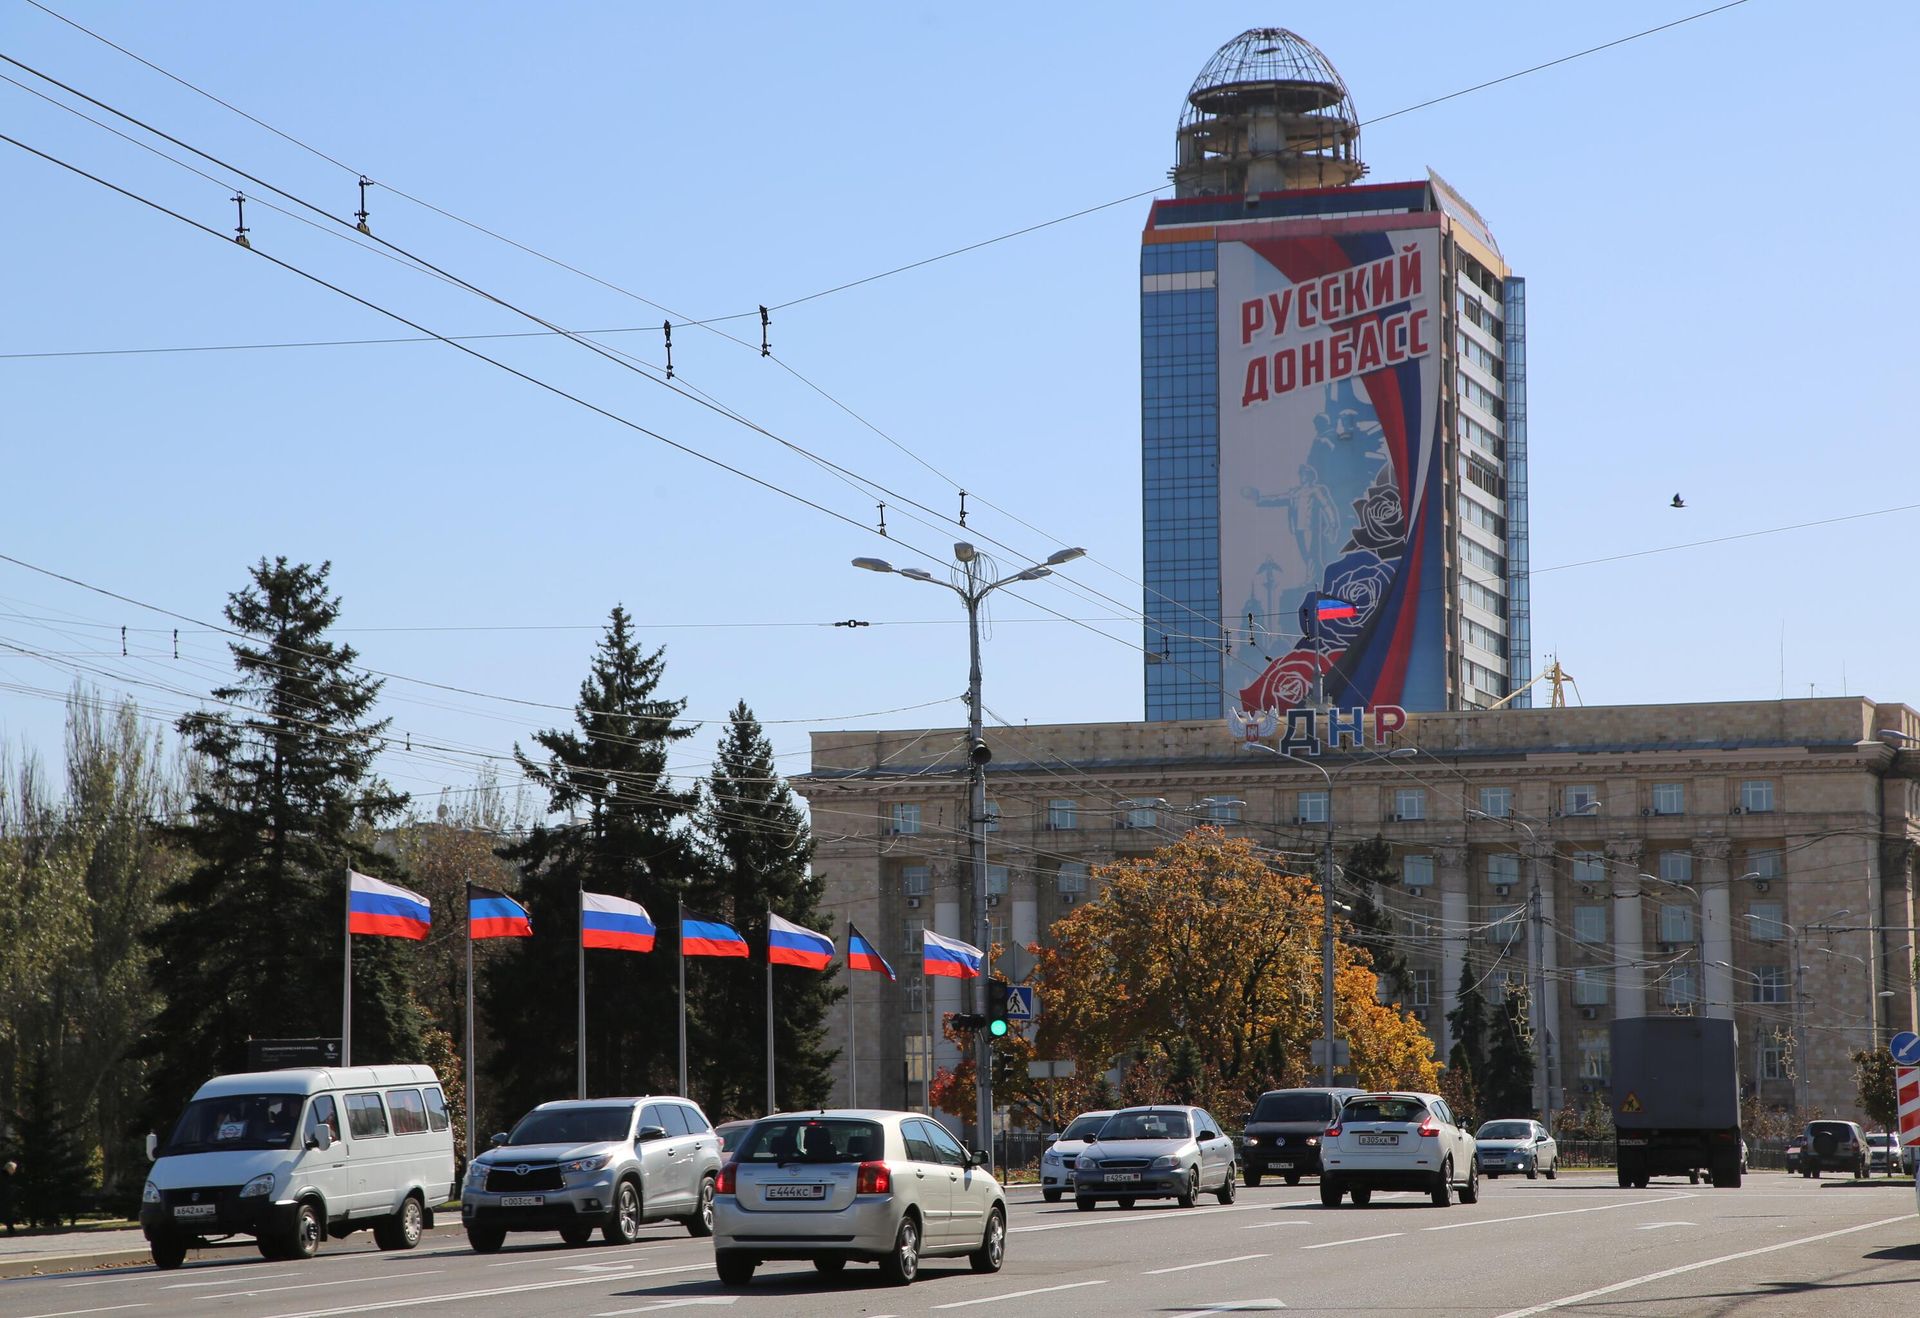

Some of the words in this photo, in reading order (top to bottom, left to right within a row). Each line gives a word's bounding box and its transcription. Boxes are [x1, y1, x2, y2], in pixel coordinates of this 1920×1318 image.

[1242, 242, 1422, 345] РУССКИЙ
[1242, 308, 1428, 407] ДОНБАСС
[1279, 704, 1408, 756] ДНР
[769, 1186, 809, 1197] Е444КС
